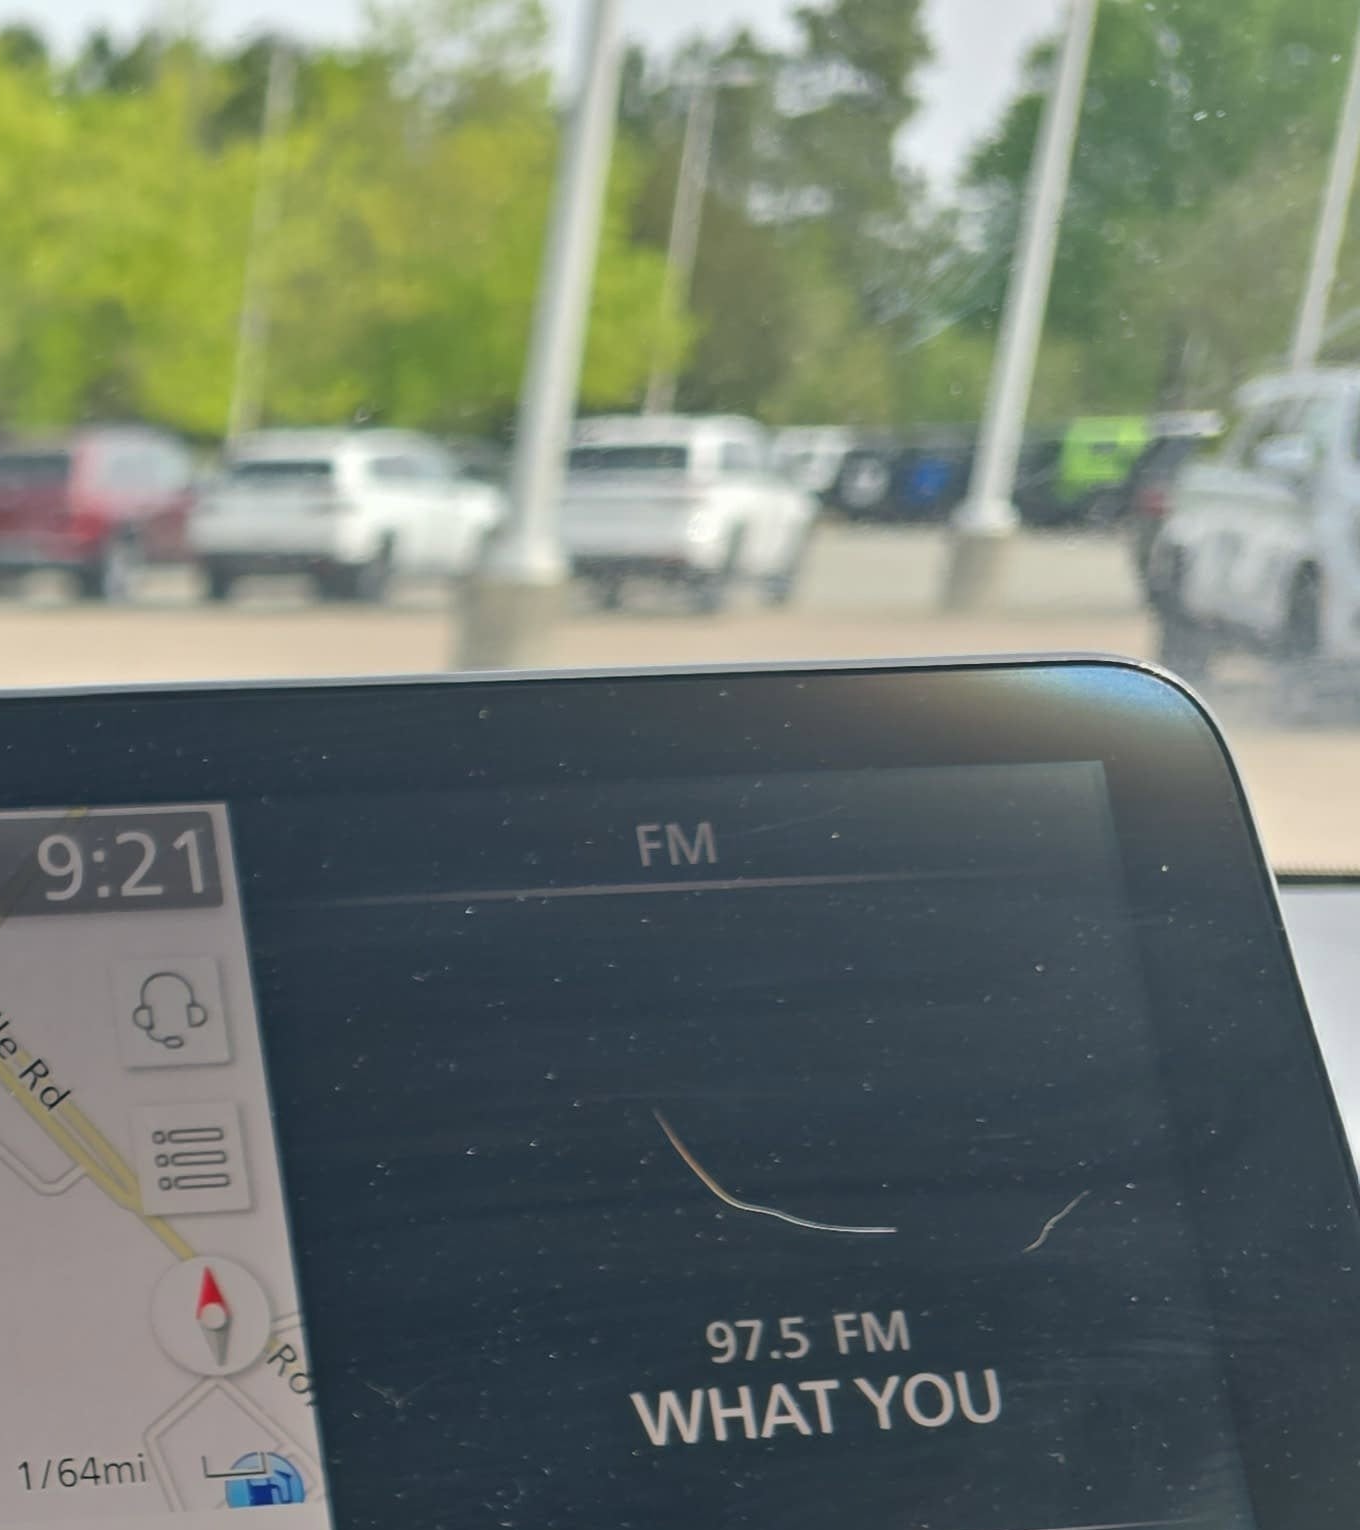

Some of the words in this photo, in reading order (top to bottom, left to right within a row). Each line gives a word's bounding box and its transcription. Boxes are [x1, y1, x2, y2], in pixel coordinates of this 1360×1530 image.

[36, 829, 216, 900] 9:21
[636, 822, 720, 867] FM
[18, 1058, 72, 1111] Rd
[705, 1316, 811, 1366] 97.5
[834, 1310, 911, 1358] FM
[629, 1379, 842, 1447] WHAT
[853, 1369, 1003, 1430] YOU
[17, 1452, 147, 1491] 1/64mi
